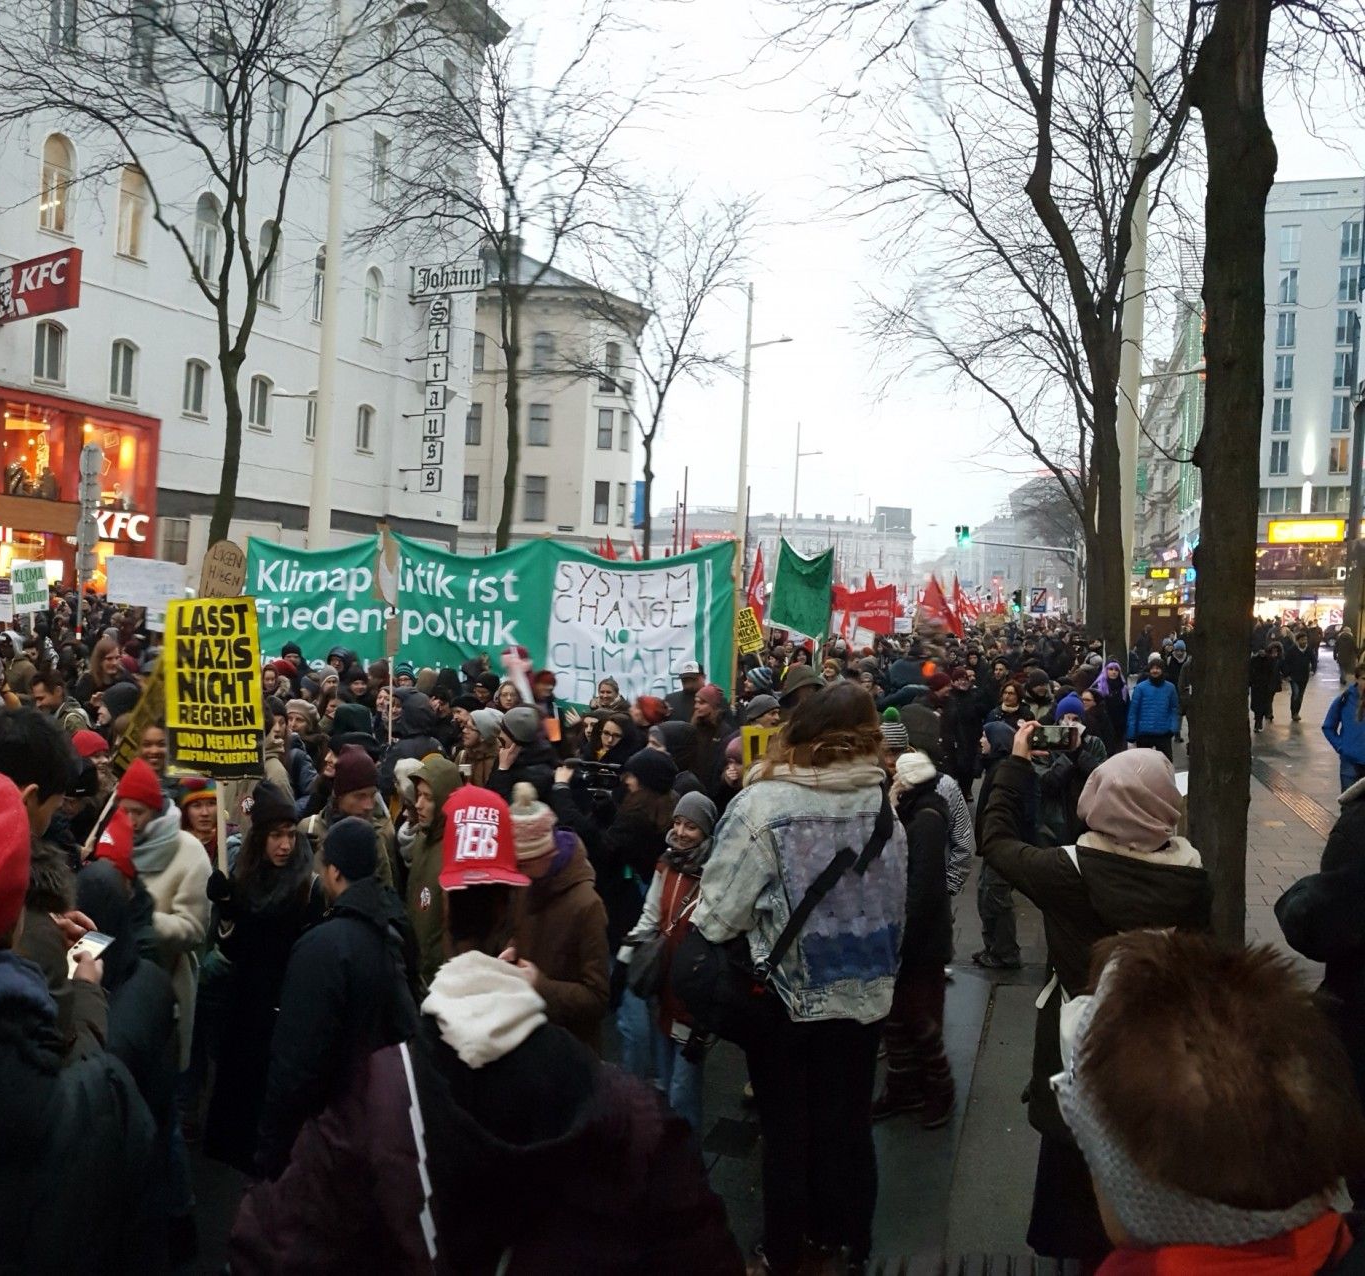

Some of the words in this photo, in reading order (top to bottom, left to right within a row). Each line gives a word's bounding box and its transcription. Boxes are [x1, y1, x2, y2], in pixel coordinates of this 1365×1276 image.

[17, 257, 70, 295] KFC
[418, 266, 483, 293] Johann
[425, 301, 448, 487] Strauss
[94, 509, 150, 542] KFC
[257, 559, 456, 602] Klimaplitik
[468, 568, 519, 603] ist
[553, 563, 691, 599] SYSTEM
[177, 604, 249, 637] LASST
[553, 594, 690, 629] CHANGE
[739, 617, 756, 629] AZIS
[605, 628, 644, 645] NOT
[176, 637, 253, 670] NAZIS
[177, 670, 254, 705] NICHT
[553, 670, 684, 702] CHNGE
[177, 732, 205, 749] UND
